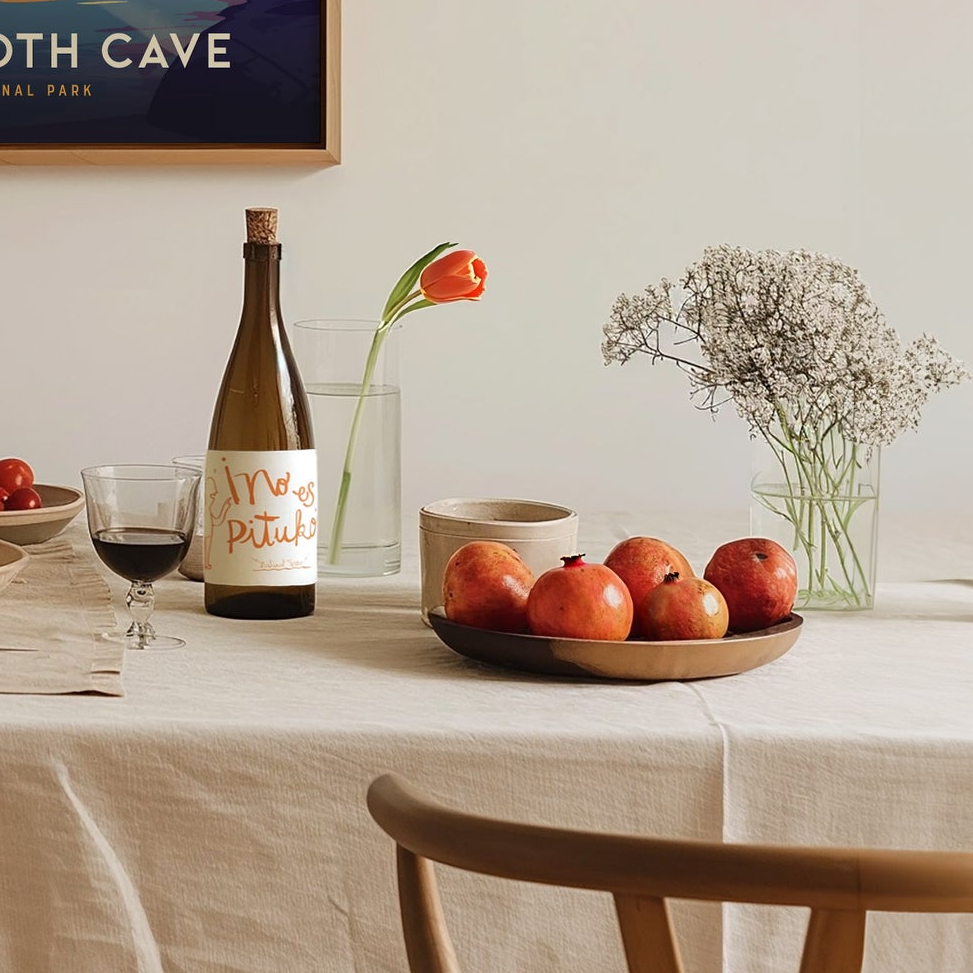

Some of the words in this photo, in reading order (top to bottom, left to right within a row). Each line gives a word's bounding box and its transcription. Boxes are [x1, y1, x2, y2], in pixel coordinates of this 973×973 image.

[100, 32, 232, 69] CAVE
[45, 83, 93, 97] PARK
[292, 481, 315, 507] es
